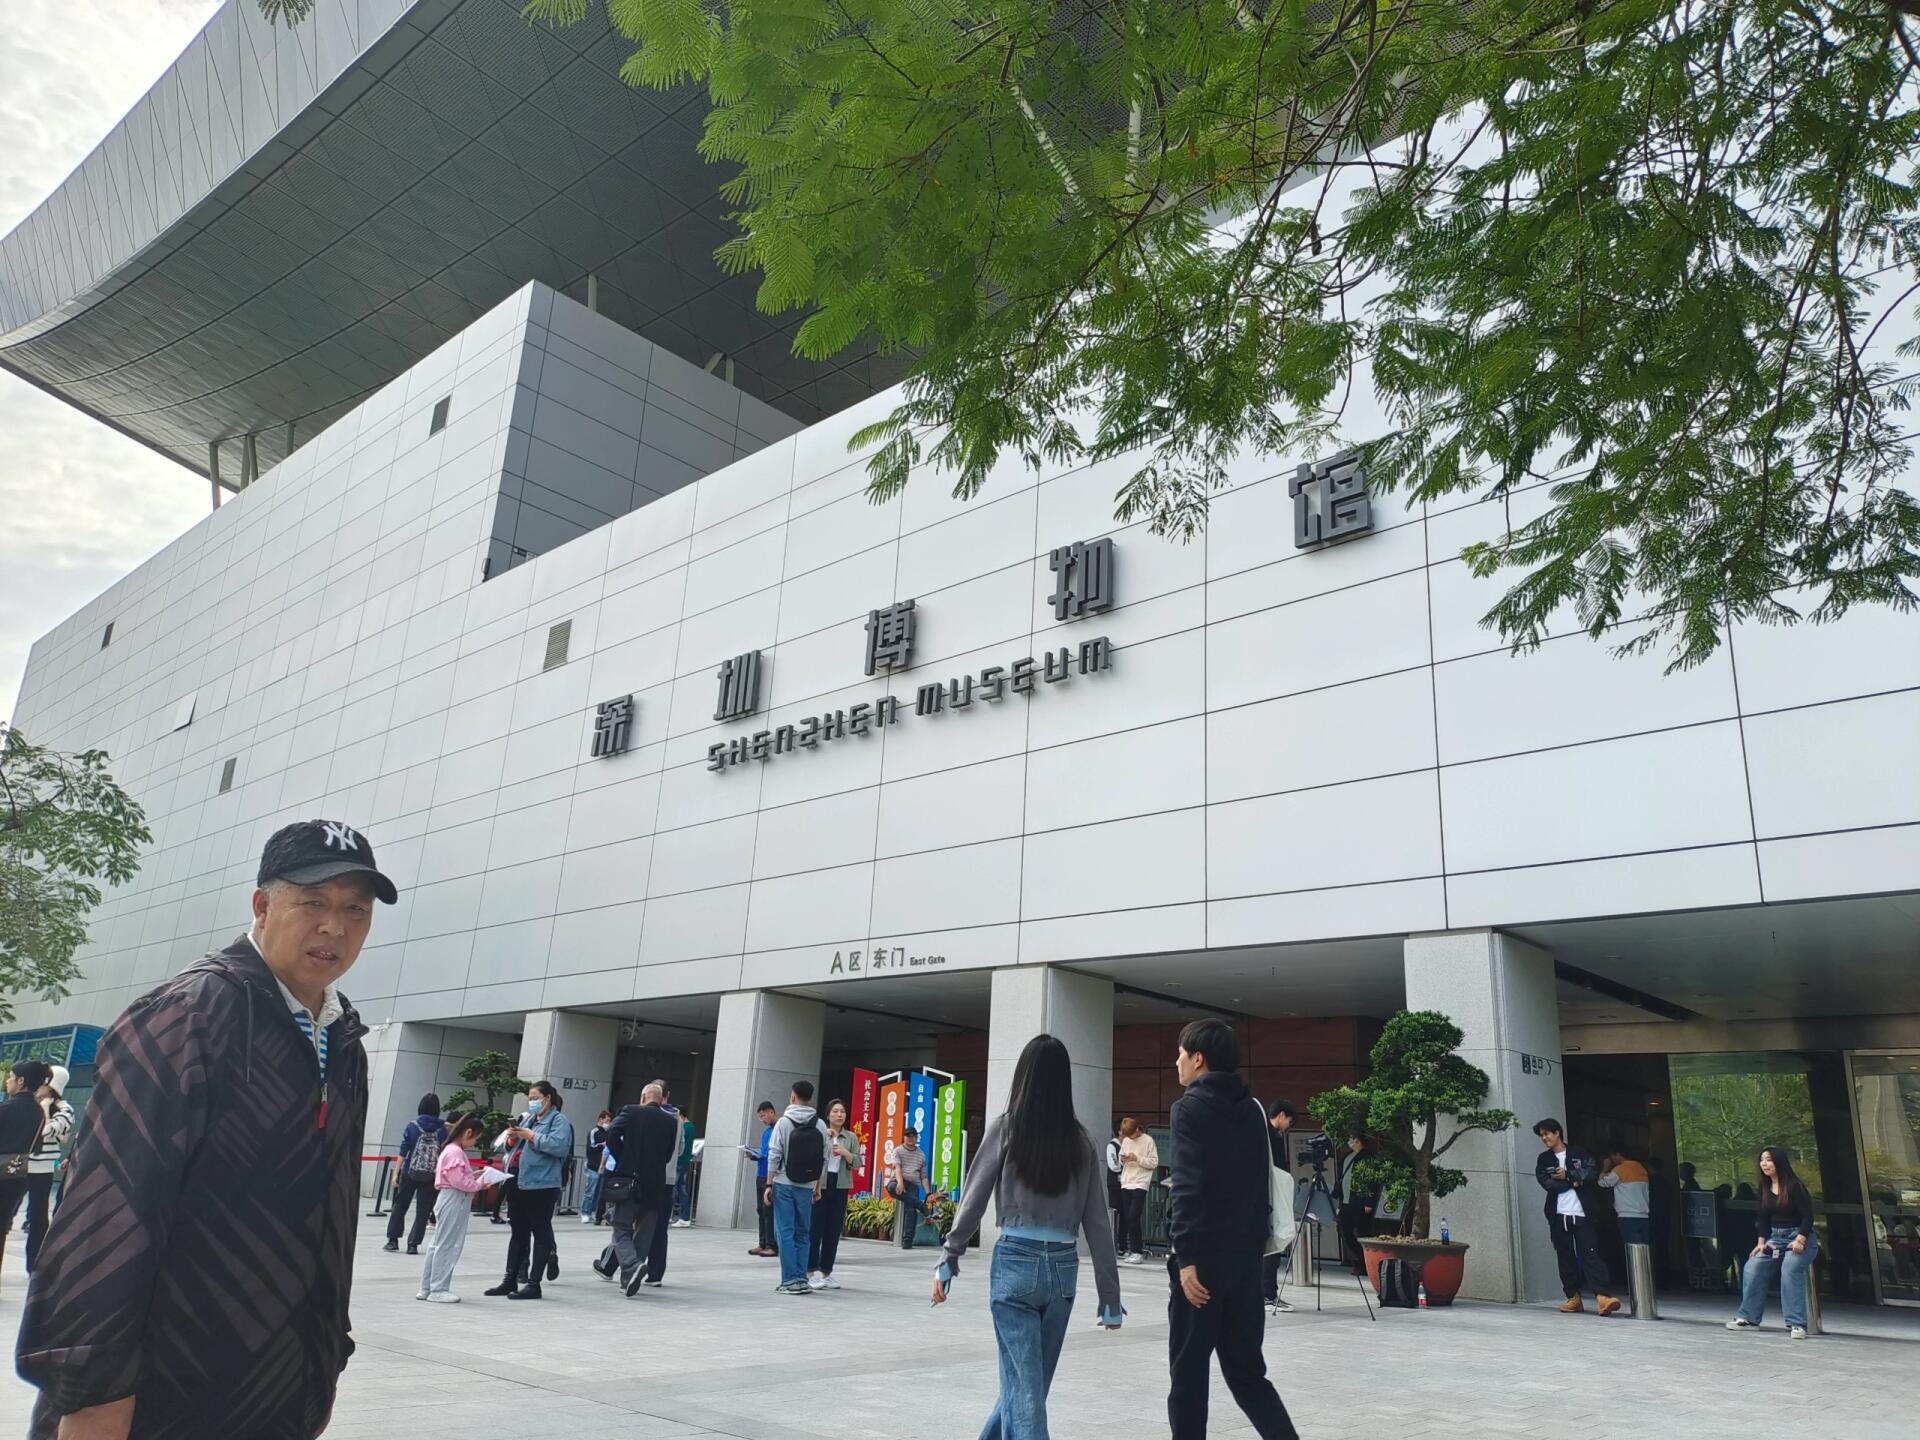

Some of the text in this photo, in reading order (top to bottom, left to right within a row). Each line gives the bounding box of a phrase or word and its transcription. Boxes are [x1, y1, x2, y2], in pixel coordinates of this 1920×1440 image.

[591, 449, 1373, 758] 深圳博物馆
[322, 821, 358, 850] NY
[910, 956, 926, 966] East
[928, 955, 945, 965] Gate
